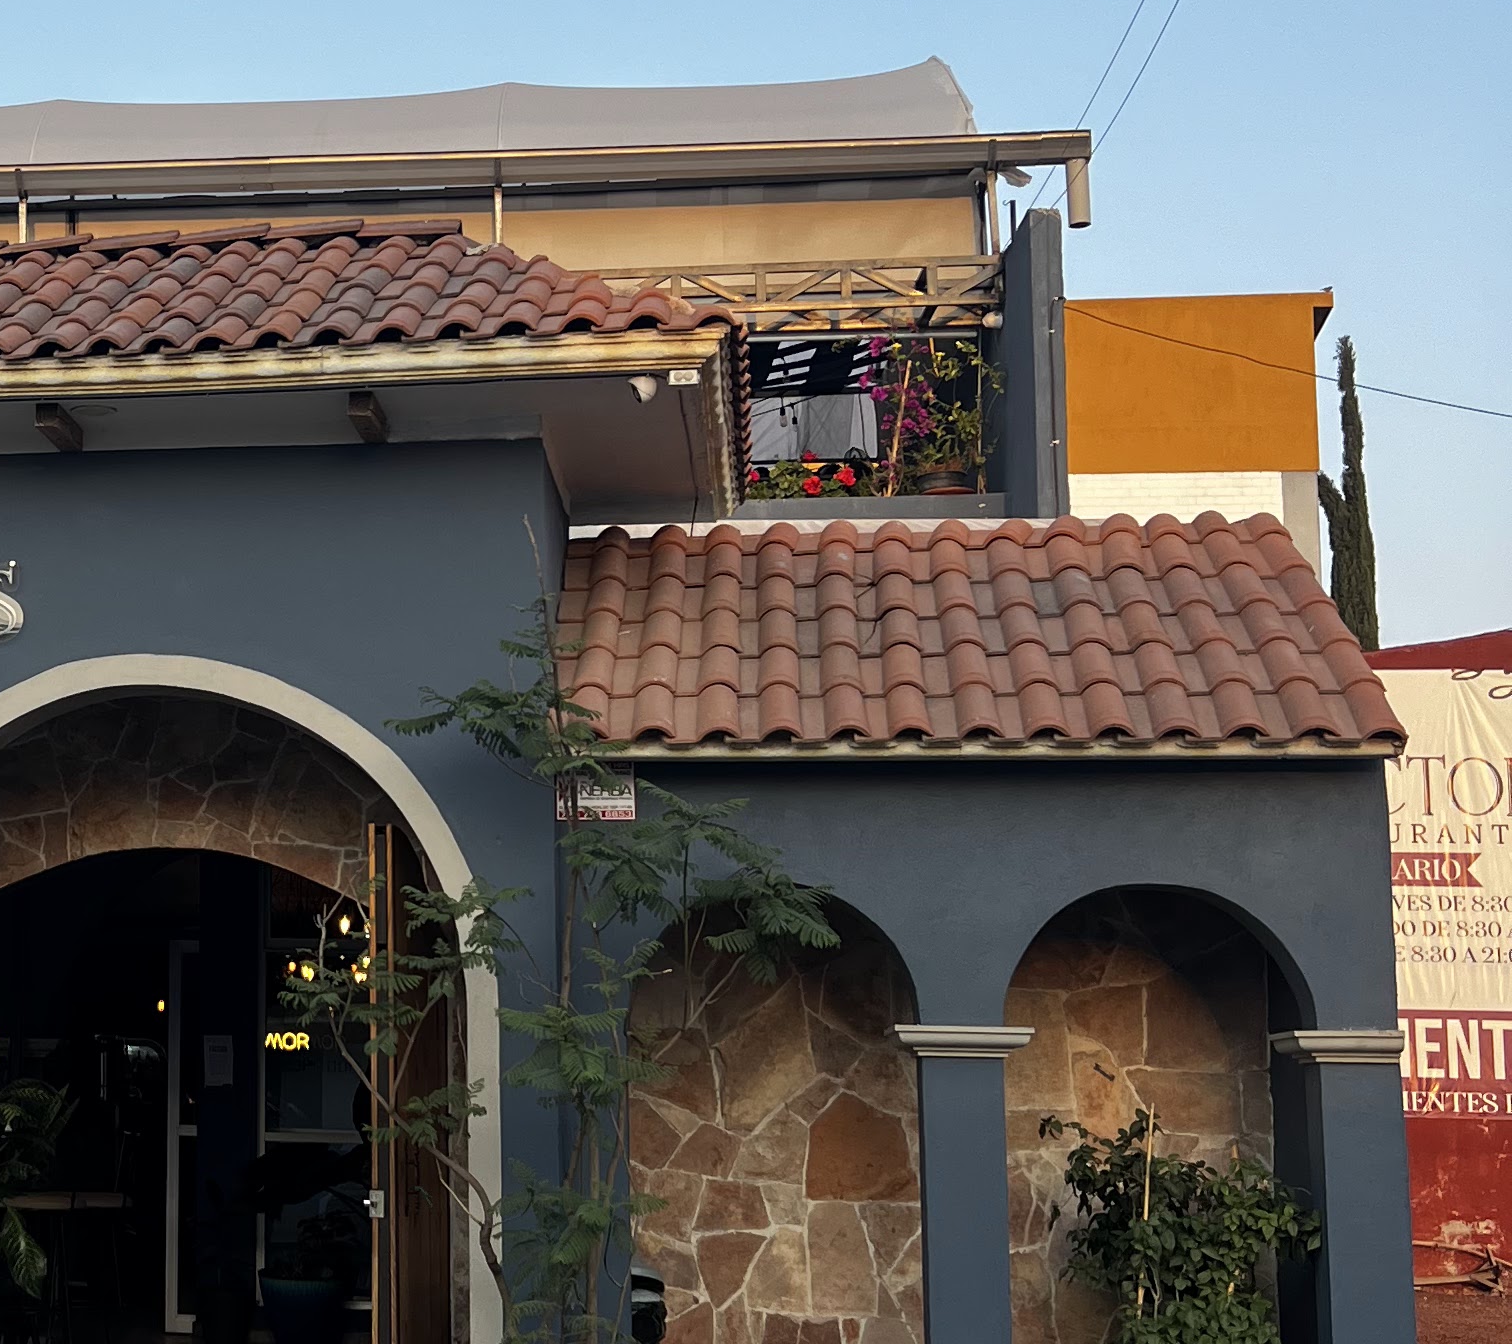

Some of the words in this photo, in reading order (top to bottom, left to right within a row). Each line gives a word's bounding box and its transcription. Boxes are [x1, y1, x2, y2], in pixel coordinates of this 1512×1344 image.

[1392, 858, 1461, 881] ARIO
[1392, 895, 1432, 912] VES
[1438, 895, 1466, 912] DE
[1423, 920, 1450, 937] DE
[1456, 920, 1502, 938] 8:30
[1411, 945, 1457, 964] 8:30
[1462, 946, 1477, 964] A
[265, 1031, 311, 1052] MOR
